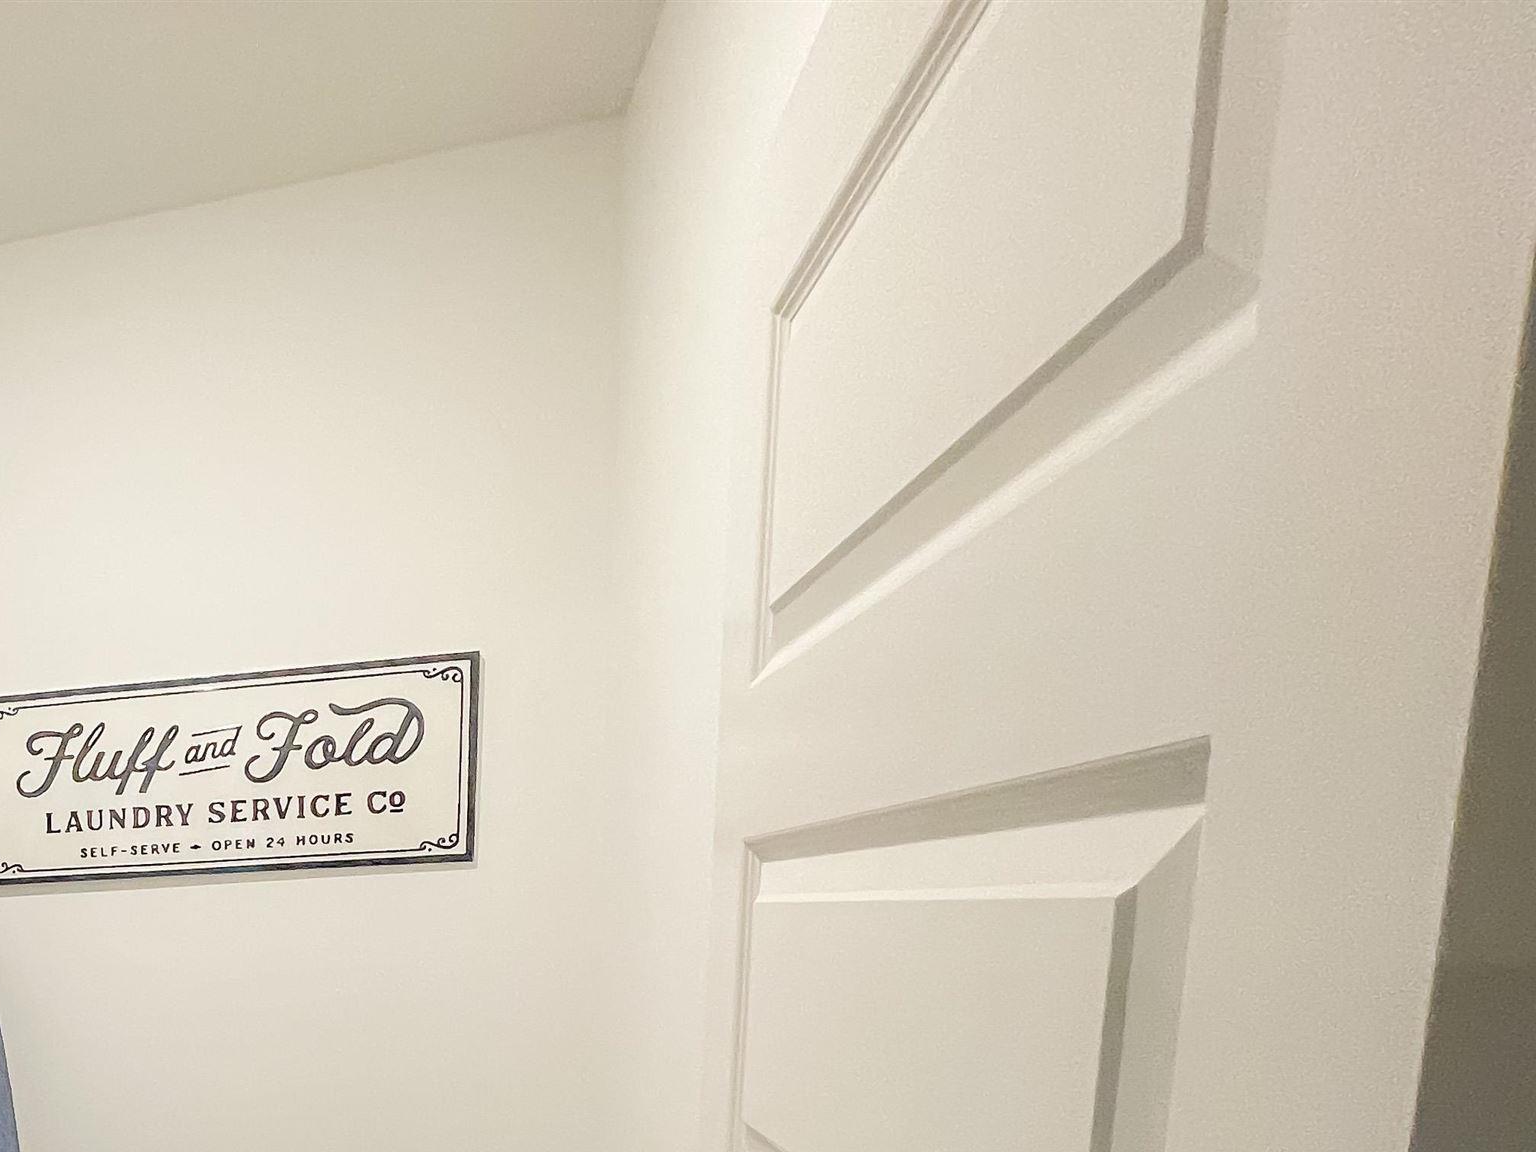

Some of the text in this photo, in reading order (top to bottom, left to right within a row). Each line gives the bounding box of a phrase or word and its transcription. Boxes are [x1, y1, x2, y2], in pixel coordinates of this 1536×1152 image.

[16, 697, 425, 798] Fluff and Fold
[45, 803, 194, 834] LAUNDRY
[208, 792, 352, 823] SERVICE
[80, 833, 355, 858] SELF-SERVE OPEN 24 HOURS
